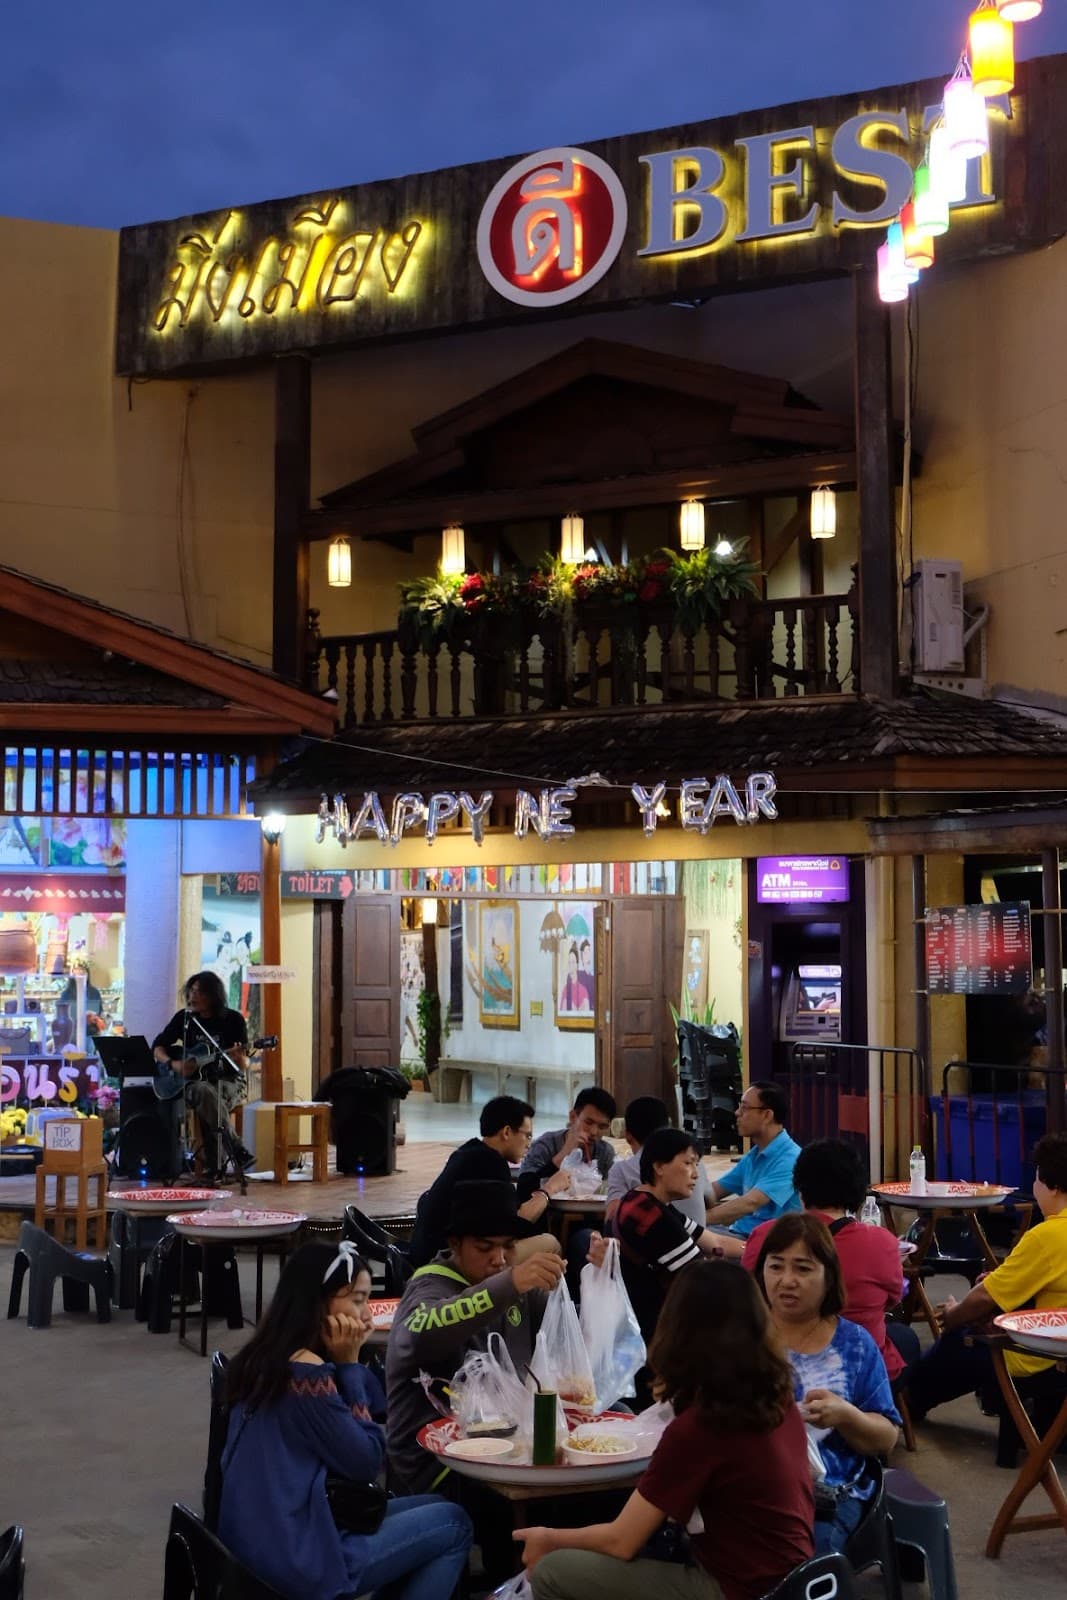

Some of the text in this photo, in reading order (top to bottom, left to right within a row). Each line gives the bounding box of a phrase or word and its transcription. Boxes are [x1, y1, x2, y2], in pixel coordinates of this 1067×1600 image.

[512, 158, 576, 276] ดี
[316, 790, 494, 848] HAPPY
[762, 874, 791, 887] ATM
[54, 1126, 71, 1136] TIP
[52, 1137, 73, 1148] BOX
